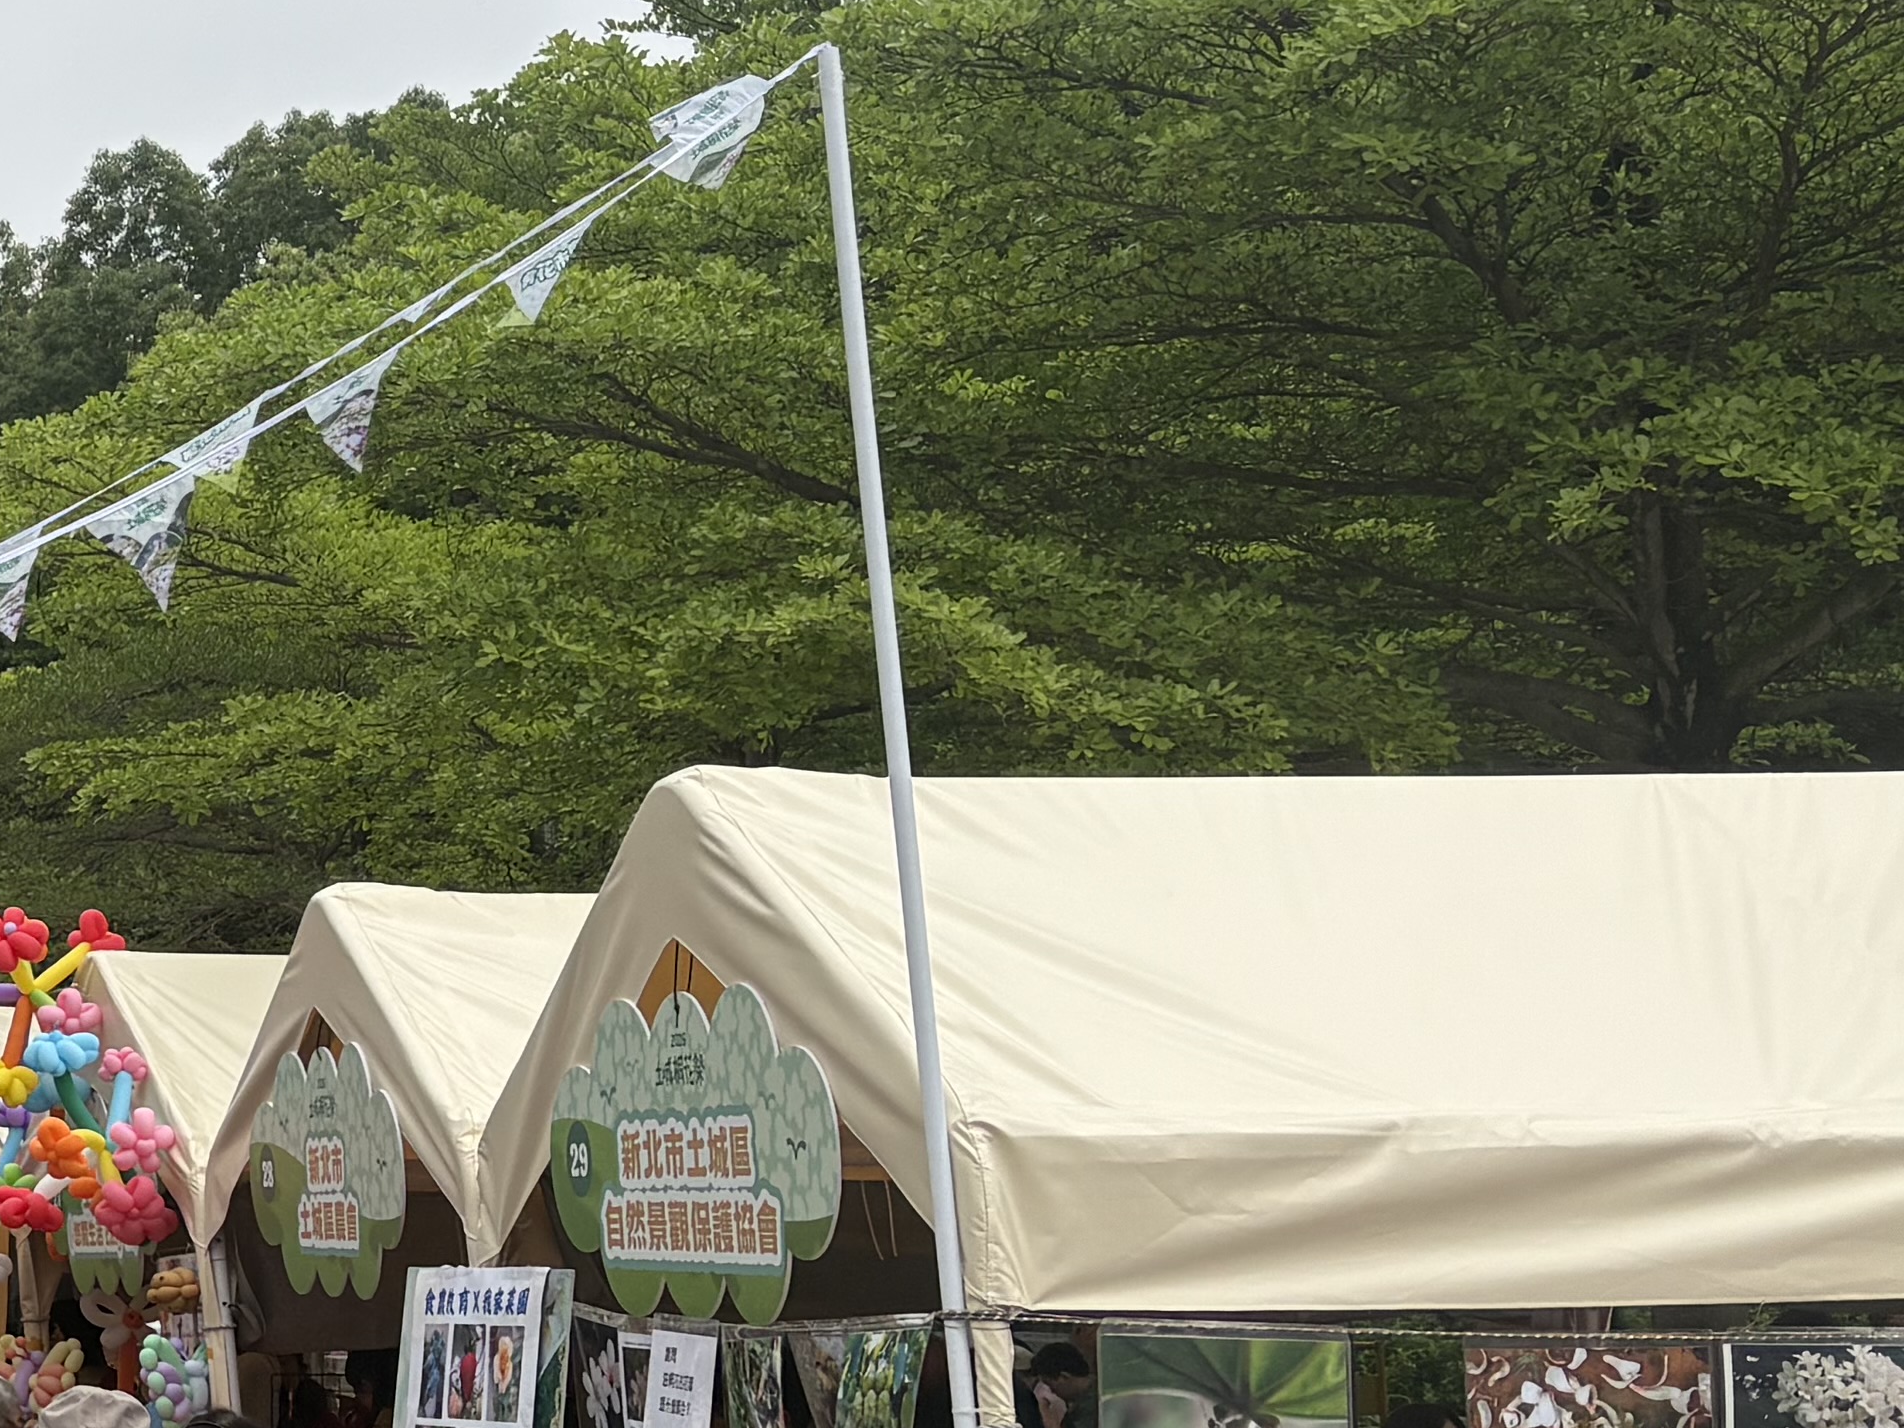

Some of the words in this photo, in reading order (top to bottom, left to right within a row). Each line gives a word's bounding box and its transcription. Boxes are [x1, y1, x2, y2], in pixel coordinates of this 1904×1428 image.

[309, 1145, 343, 1185] 新北市
[569, 1143, 589, 1178] 29
[621, 1125, 752, 1180] 新北市土城區
[301, 1201, 358, 1241] 土城區農會
[605, 1199, 779, 1256] 自然景觀保護協會
